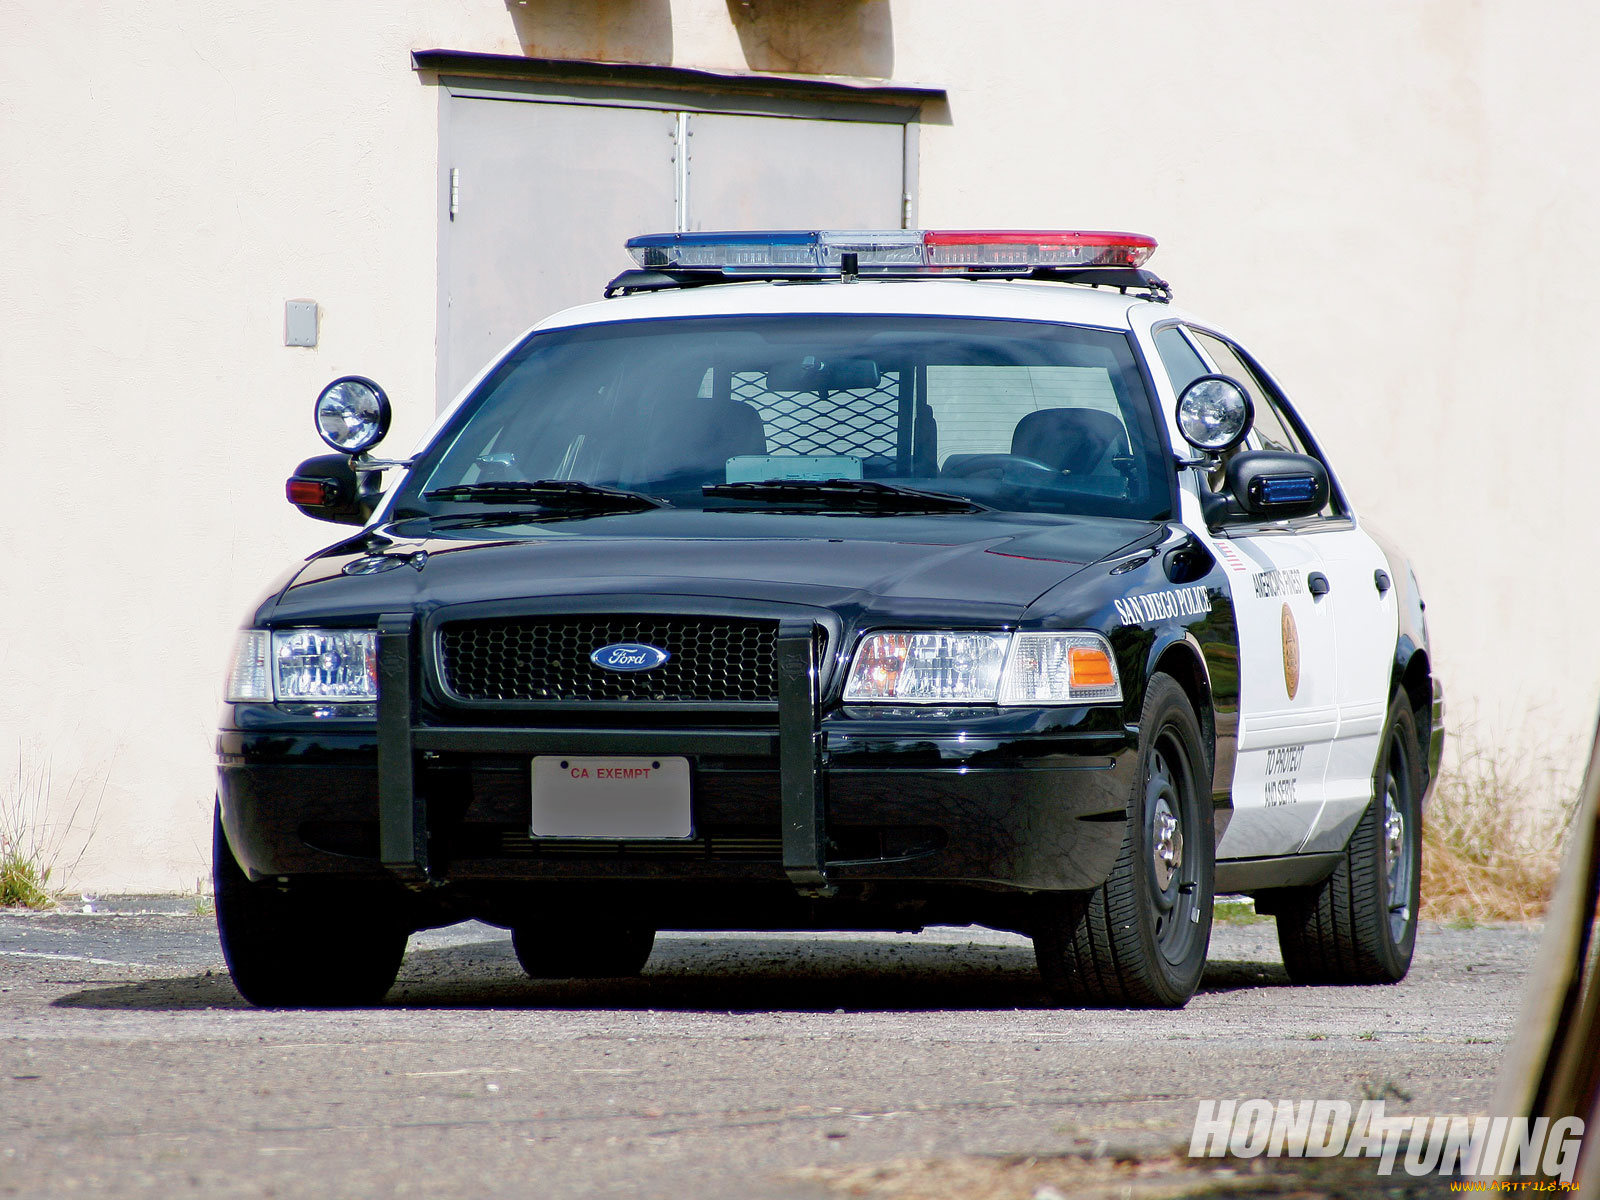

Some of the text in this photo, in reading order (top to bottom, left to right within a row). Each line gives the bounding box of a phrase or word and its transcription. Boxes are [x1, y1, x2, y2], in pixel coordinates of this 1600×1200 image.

[1114, 585, 1212, 626] SAN DIEGO POLICE
[608, 648, 646, 664] Ford
[571, 768, 651, 779] CA EXEMPT
[1265, 745, 1304, 775] TO PROTECT
[1265, 778, 1297, 808] AND SERVE
